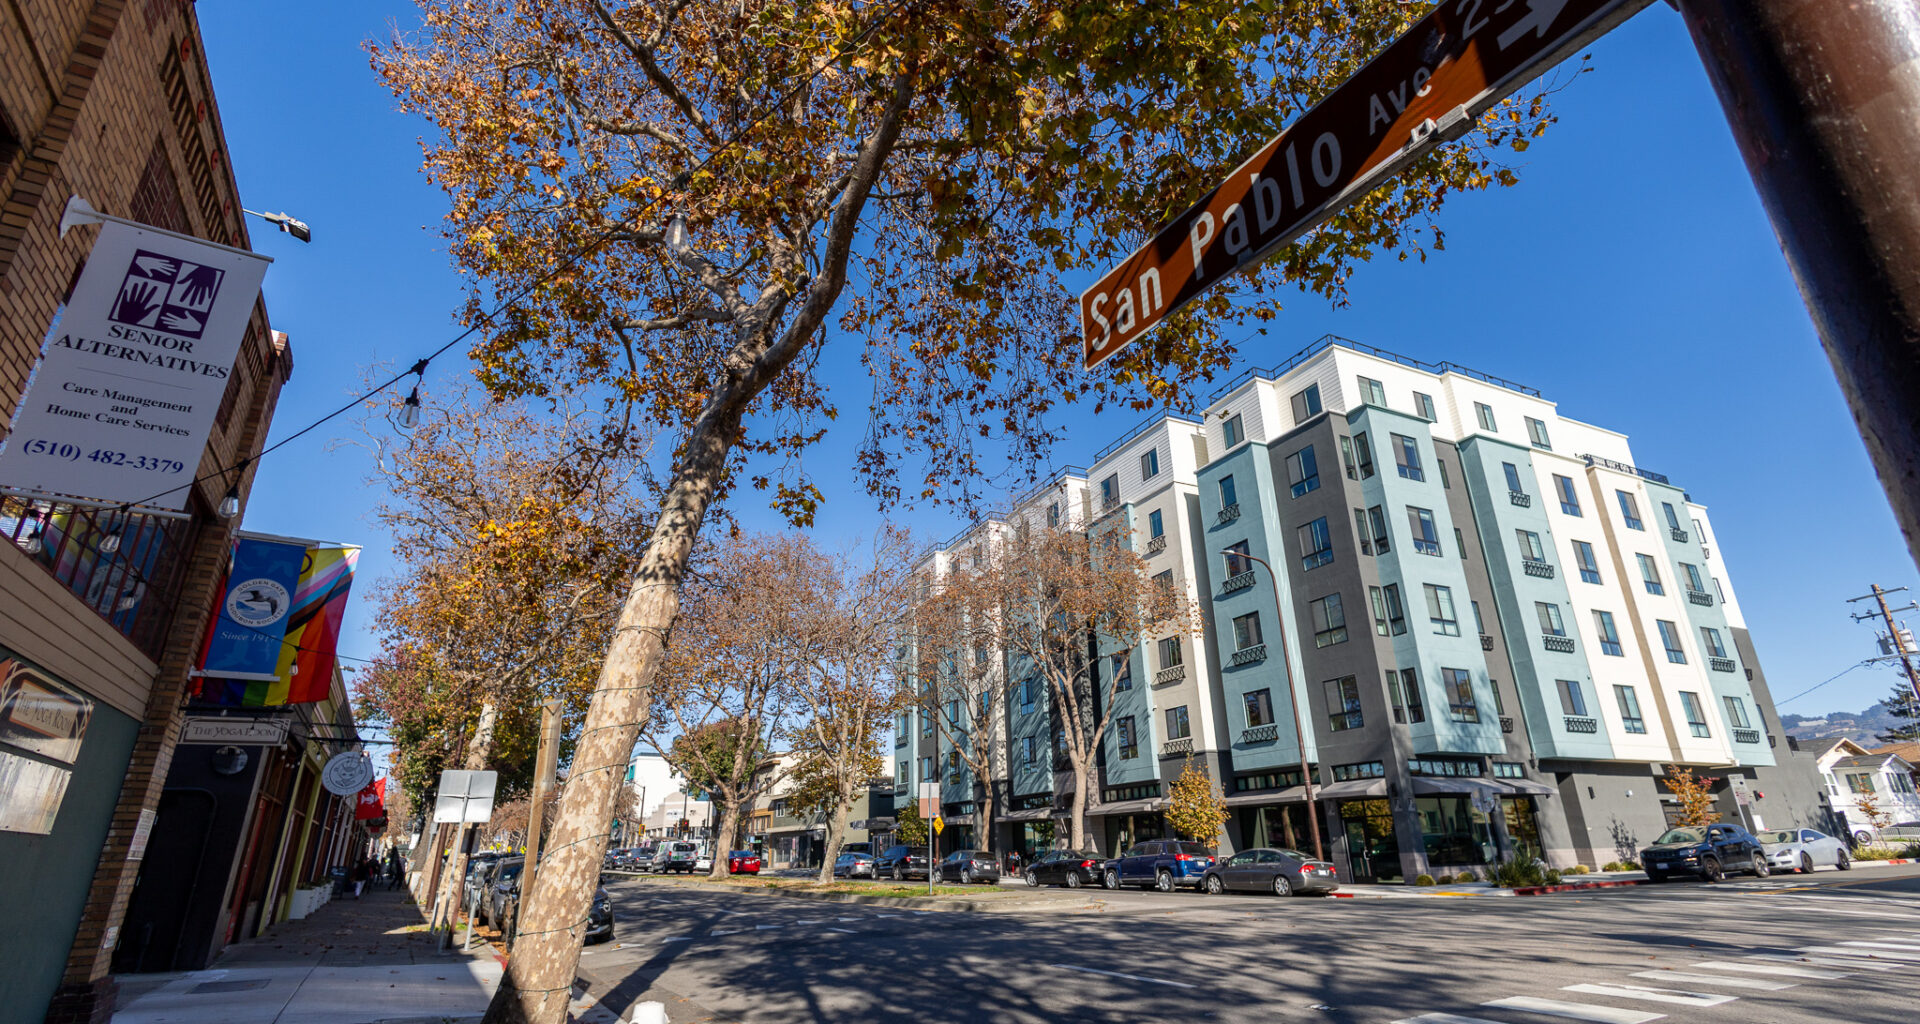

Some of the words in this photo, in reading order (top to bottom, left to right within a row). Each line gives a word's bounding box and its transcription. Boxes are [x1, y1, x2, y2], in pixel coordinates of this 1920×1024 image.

[1090, 266, 1163, 351] San
[1190, 131, 1342, 281] Pablo
[1369, 67, 1432, 136] Ave
[1456, 0, 1514, 41] 2
[107, 324, 193, 354] SENIOR
[54, 334, 229, 380] ALTERNATIVES
[62, 382, 99, 398] Care
[102, 388, 192, 414] Management
[110, 402, 138, 416] and
[46, 403, 90, 420] Home
[95, 412, 130, 427] Care
[132, 419, 191, 437] Services
[23, 438, 81, 462] (510)
[87, 449, 184, 475] 482-3379
[237, 580, 269, 592] GOLDEN
[271, 583, 286, 596] GATE
[229, 603, 254, 625] AUDUBON
[256, 608, 284, 625] SOCIETY
[221, 631, 248, 641] Since
[193, 726, 212, 736] THE
[212, 726, 243, 738] YOGA
